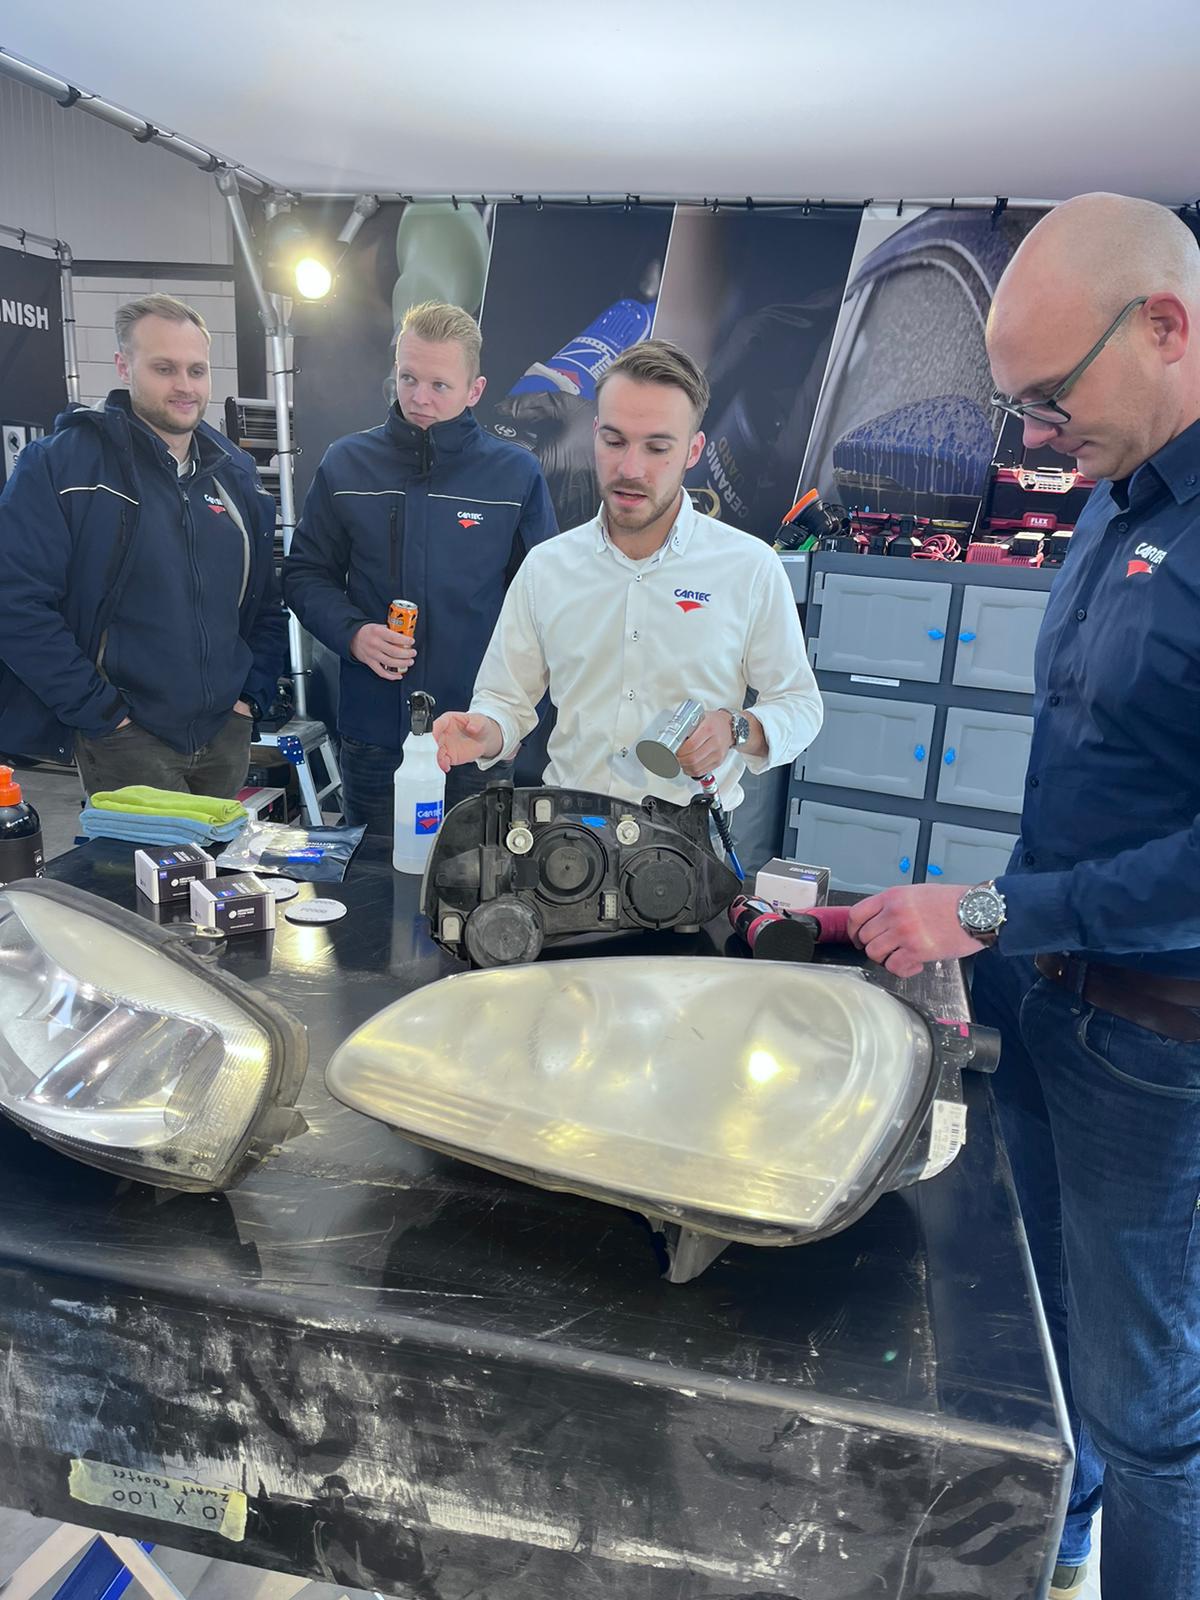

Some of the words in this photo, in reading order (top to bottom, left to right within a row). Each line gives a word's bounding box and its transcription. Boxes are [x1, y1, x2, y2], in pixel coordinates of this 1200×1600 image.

[0, 298, 49, 330] NISH
[706, 441, 749, 518] CERAMIC
[1030, 517, 1049, 526] FLEX
[673, 588, 712, 602] CARTEC
[112, 1490, 157, 1509] 1.00
[173, 1498, 187, 1515] X
